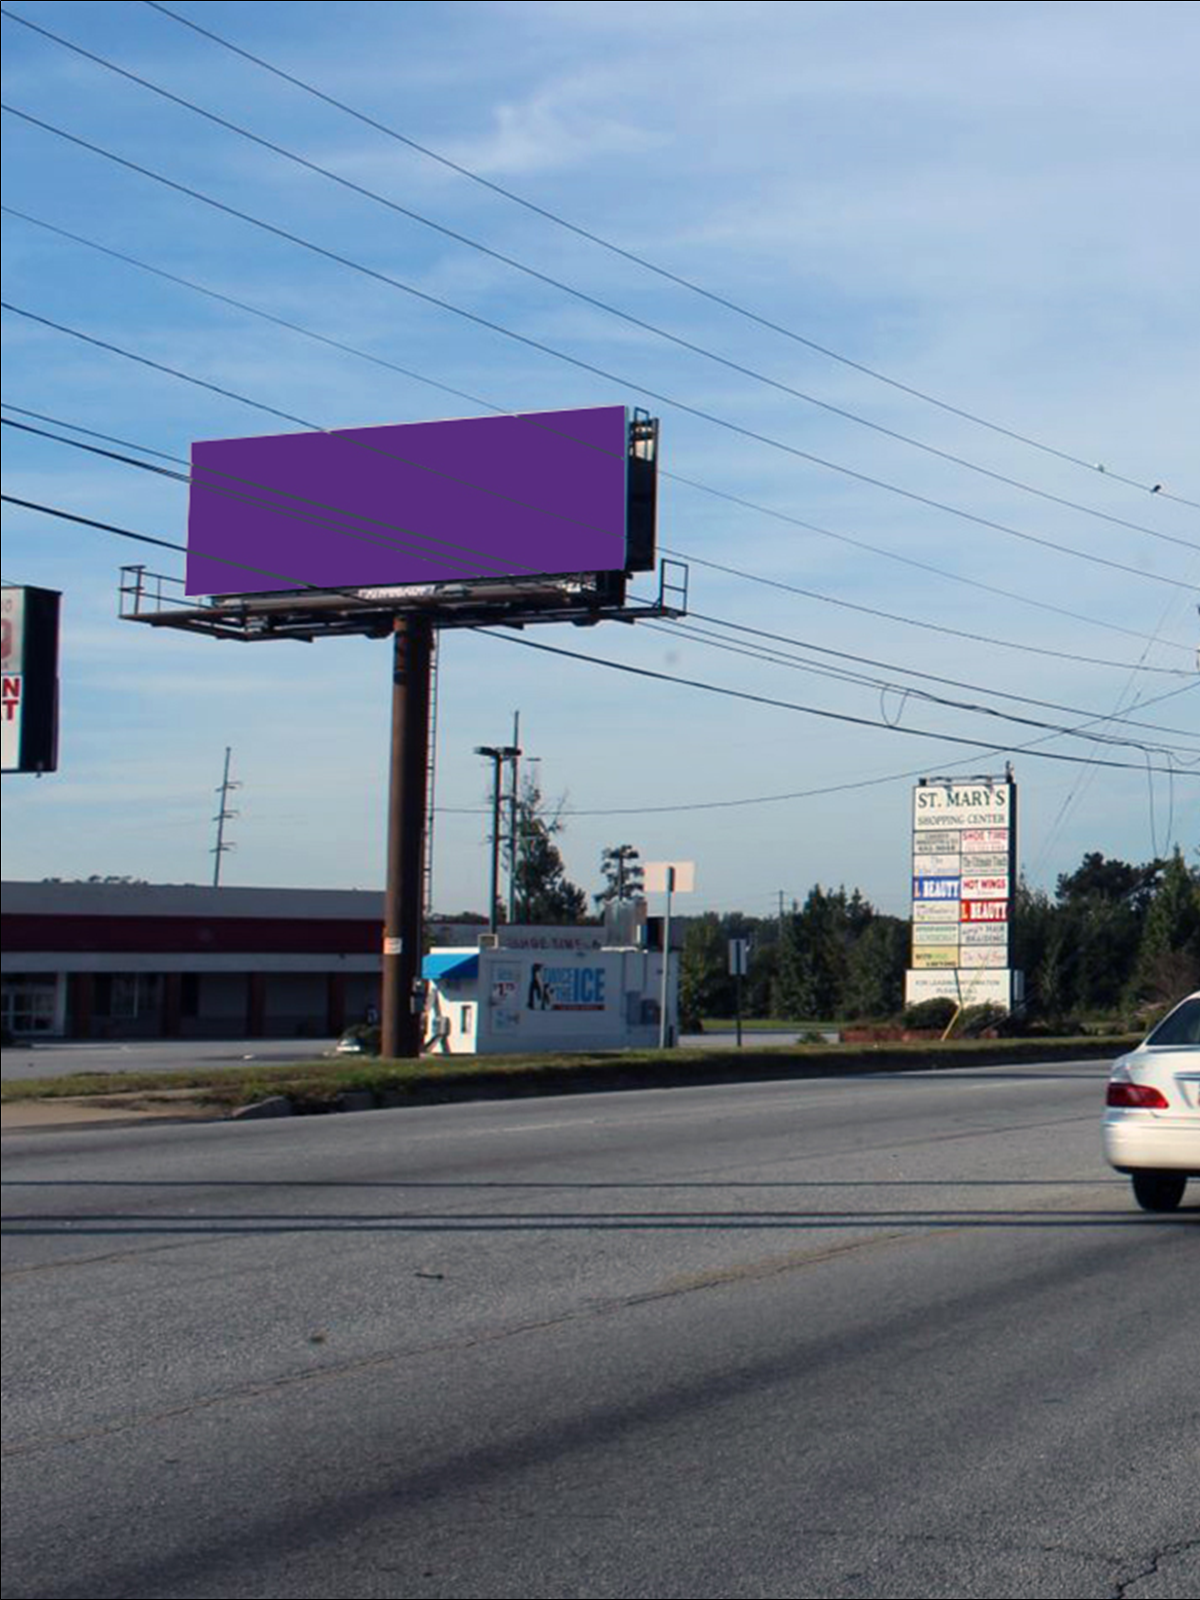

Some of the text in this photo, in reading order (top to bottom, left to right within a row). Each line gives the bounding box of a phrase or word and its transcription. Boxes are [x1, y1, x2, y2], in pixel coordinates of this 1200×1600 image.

[918, 792, 942, 808] ST.
[917, 813, 1005, 827] SHOPPING CENTER
[923, 880, 959, 898] BEAUTY
[962, 878, 1006, 891] HOT WINGS
[970, 902, 1008, 919] BEAUTY
[573, 968, 605, 1003] ICE
